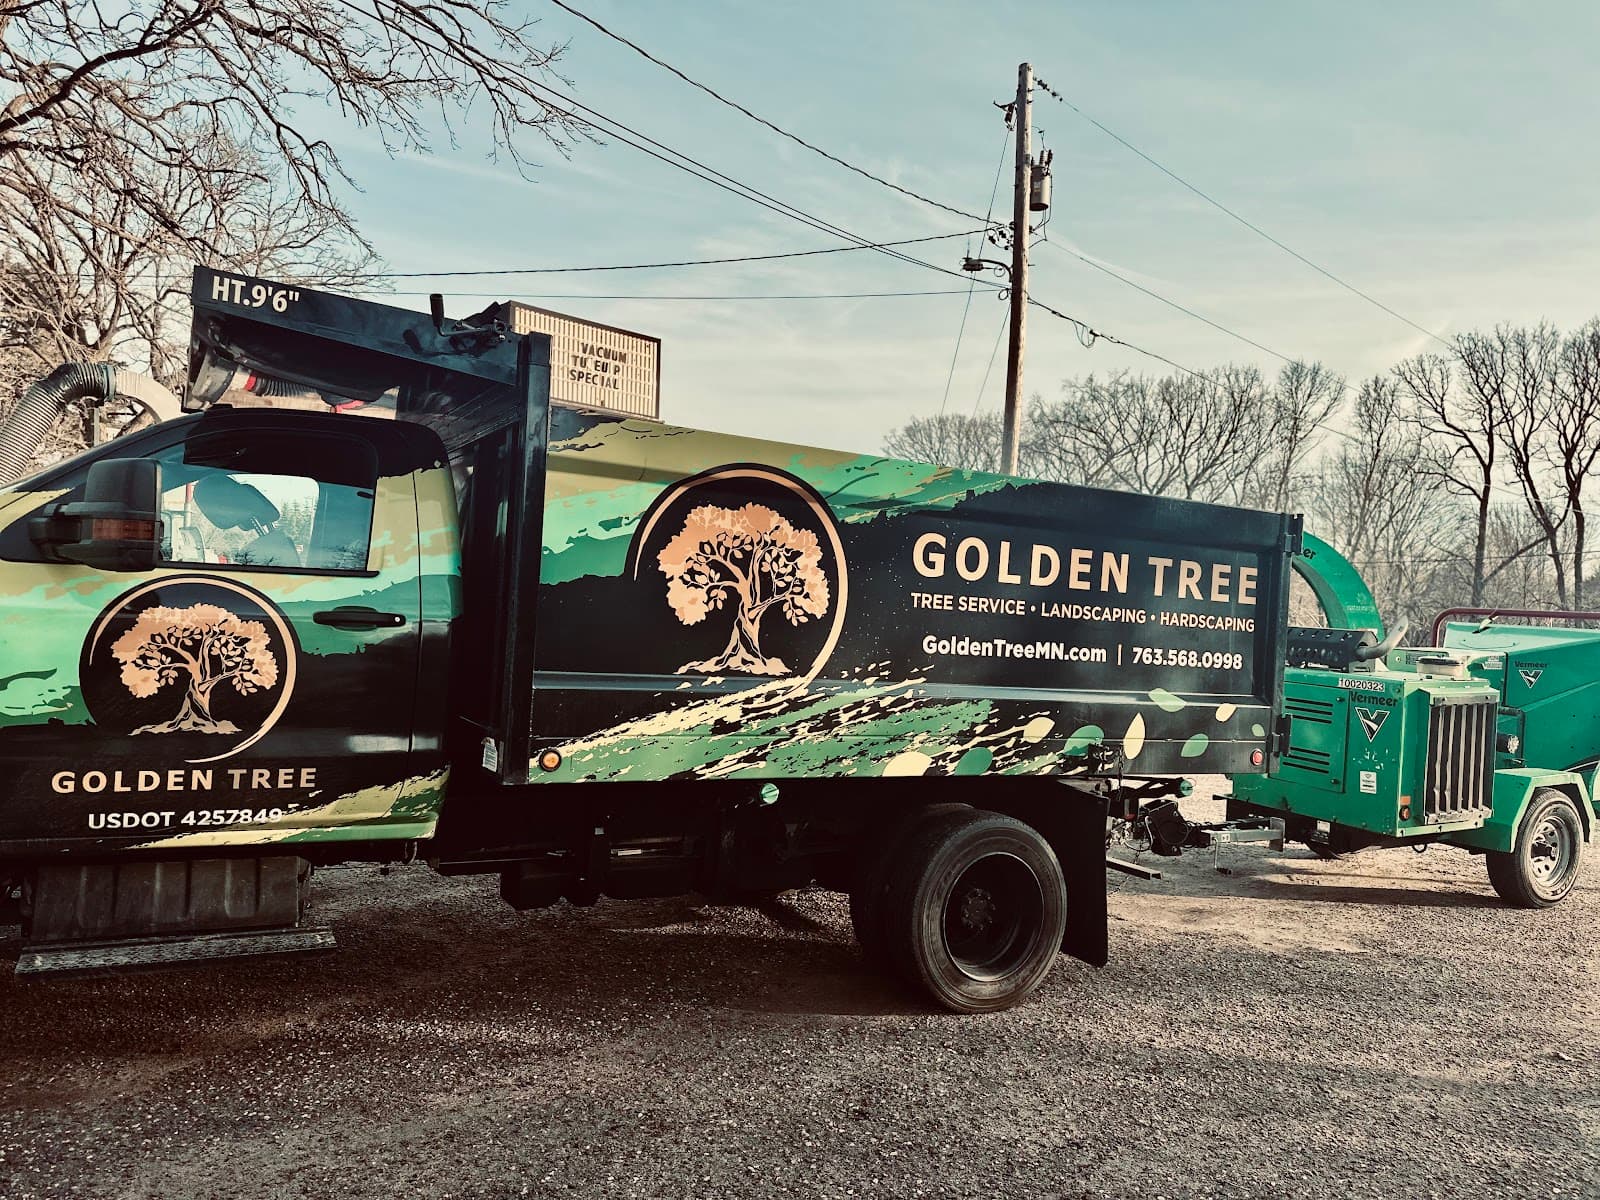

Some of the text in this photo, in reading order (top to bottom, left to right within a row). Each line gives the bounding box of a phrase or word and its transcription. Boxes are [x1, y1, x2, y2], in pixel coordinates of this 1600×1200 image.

[581, 342, 626, 363] VACUUM
[569, 369, 620, 390] SPECIAL
[912, 532, 1259, 605] GOLDEN TREE
[911, 592, 1255, 632] TREE SERVICE LANDSCAPING HARDSCAPING
[922, 634, 1243, 670] GoldenTreeMN.com 763.568.0998
[1514, 660, 1548, 669] Vermeer
[1339, 679, 1385, 692] 10020323
[1350, 692, 1398, 707] Vermeer
[51, 767, 318, 793] GOLDEN TREE
[88, 807, 283, 829] USDOT 4257849
